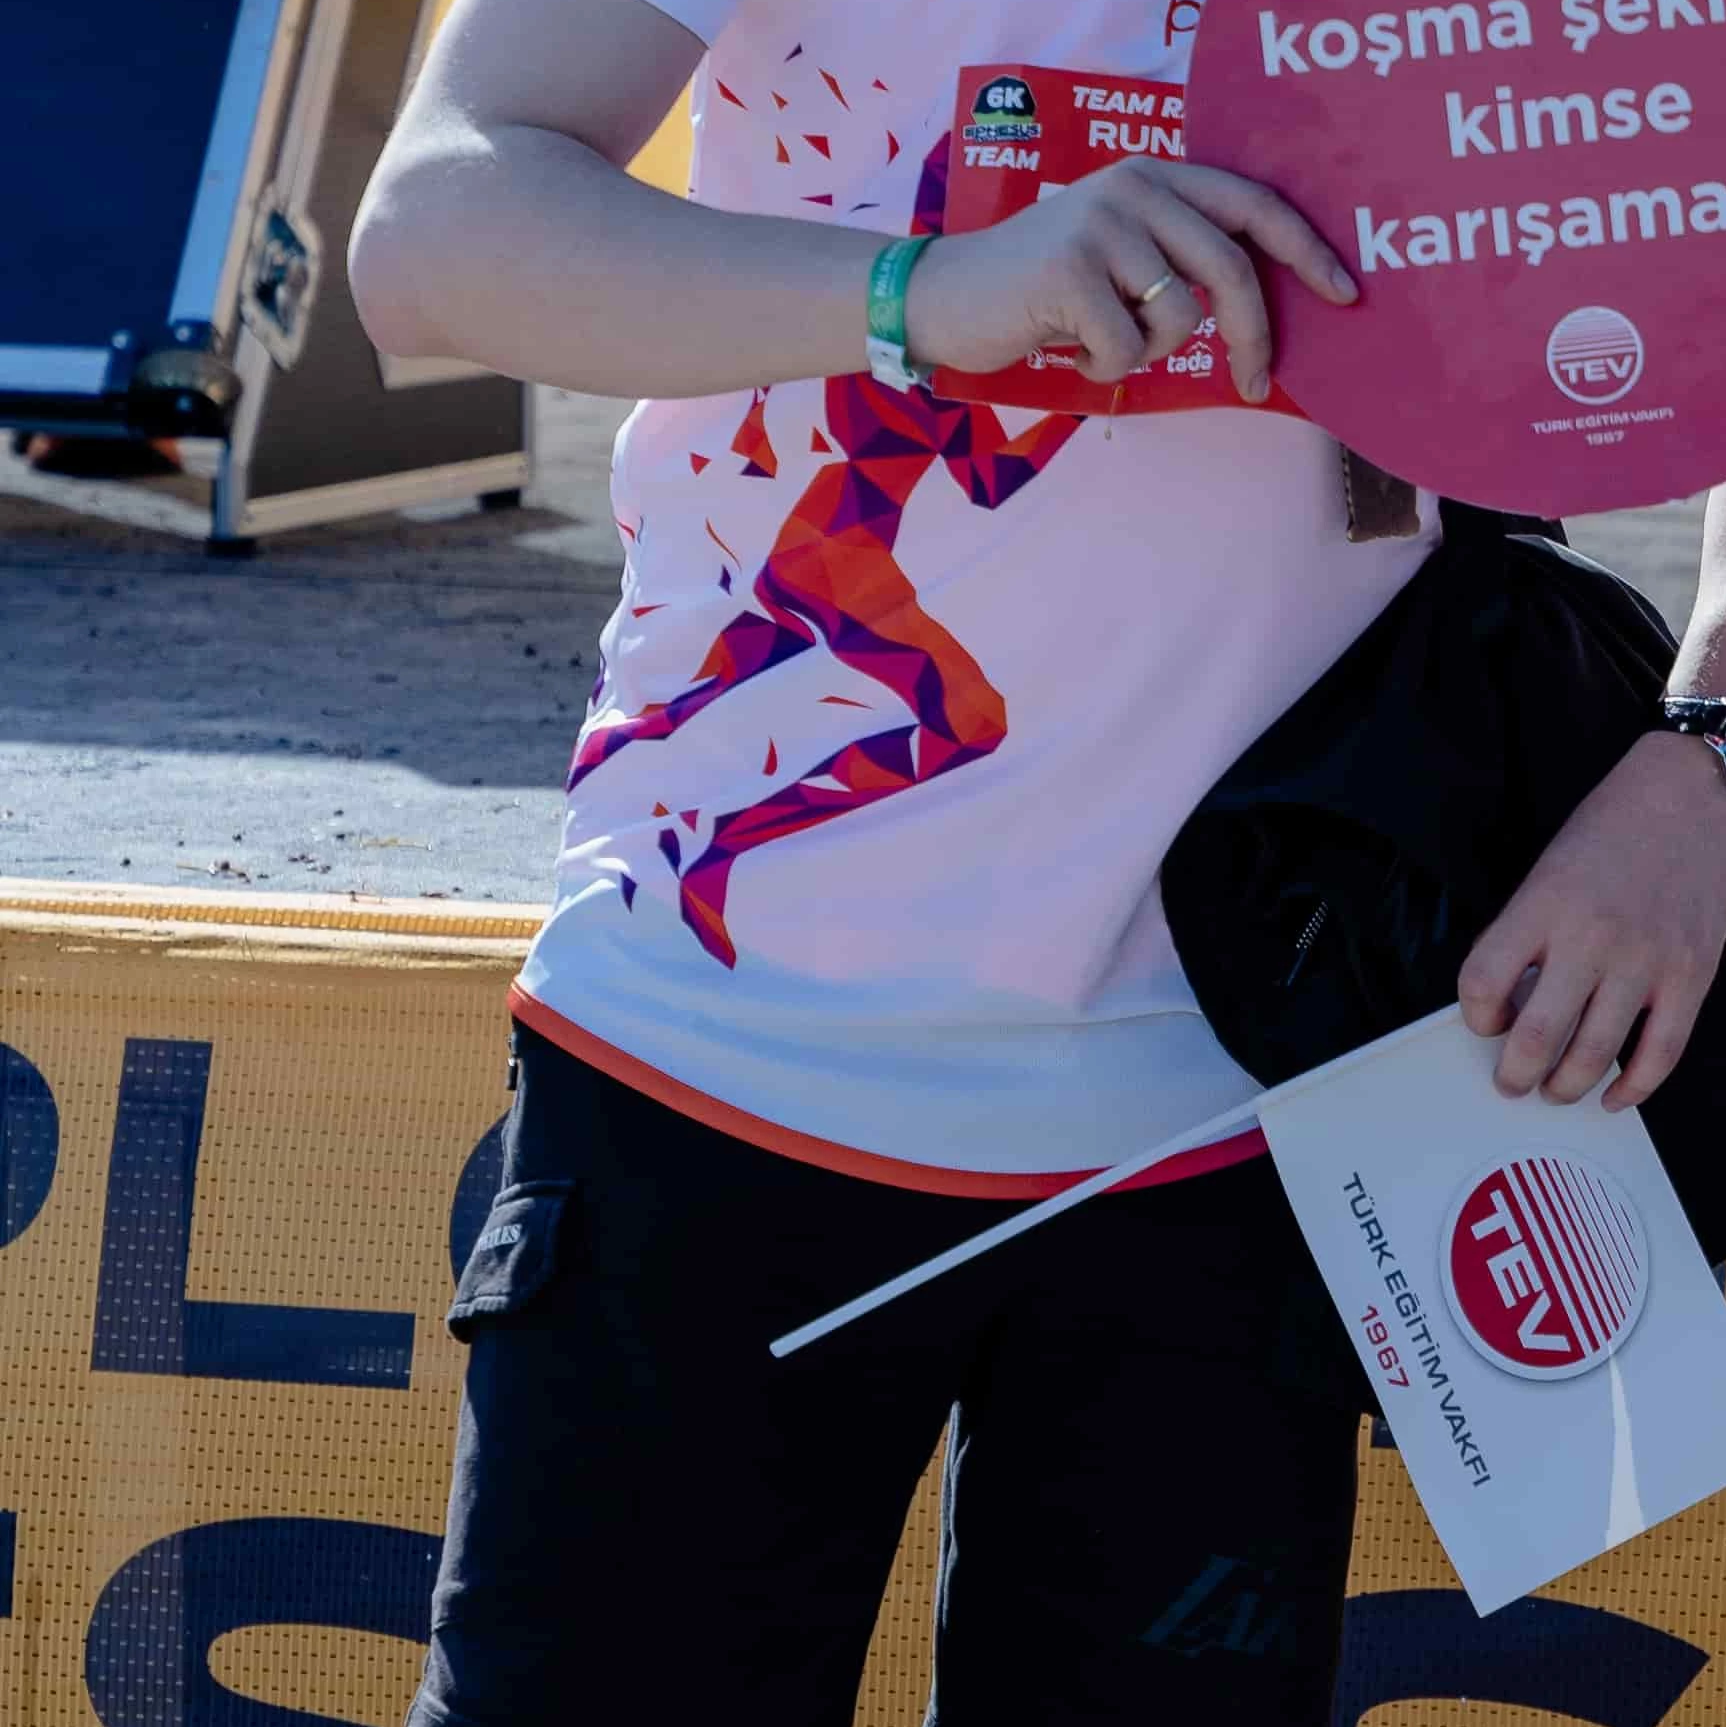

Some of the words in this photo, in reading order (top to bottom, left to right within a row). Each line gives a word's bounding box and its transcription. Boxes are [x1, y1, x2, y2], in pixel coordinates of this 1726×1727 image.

[986, 85, 1025, 110] 6K
[1072, 85, 1156, 117] TEAM
[1443, 80, 1693, 160] kimse
[1088, 119, 1185, 157] RUN
[963, 145, 1041, 172] TEAM
[1166, 351, 1214, 374] tada
[1559, 354, 1634, 385] TEV
[1470, 1187, 1572, 1355] TEV
[1341, 1171, 1395, 1265] TÜRK
[1383, 1268, 1452, 1390] EĞİTİM
[1438, 1388, 1493, 1489] VAKFI
[1358, 1302, 1411, 1391] 1967
